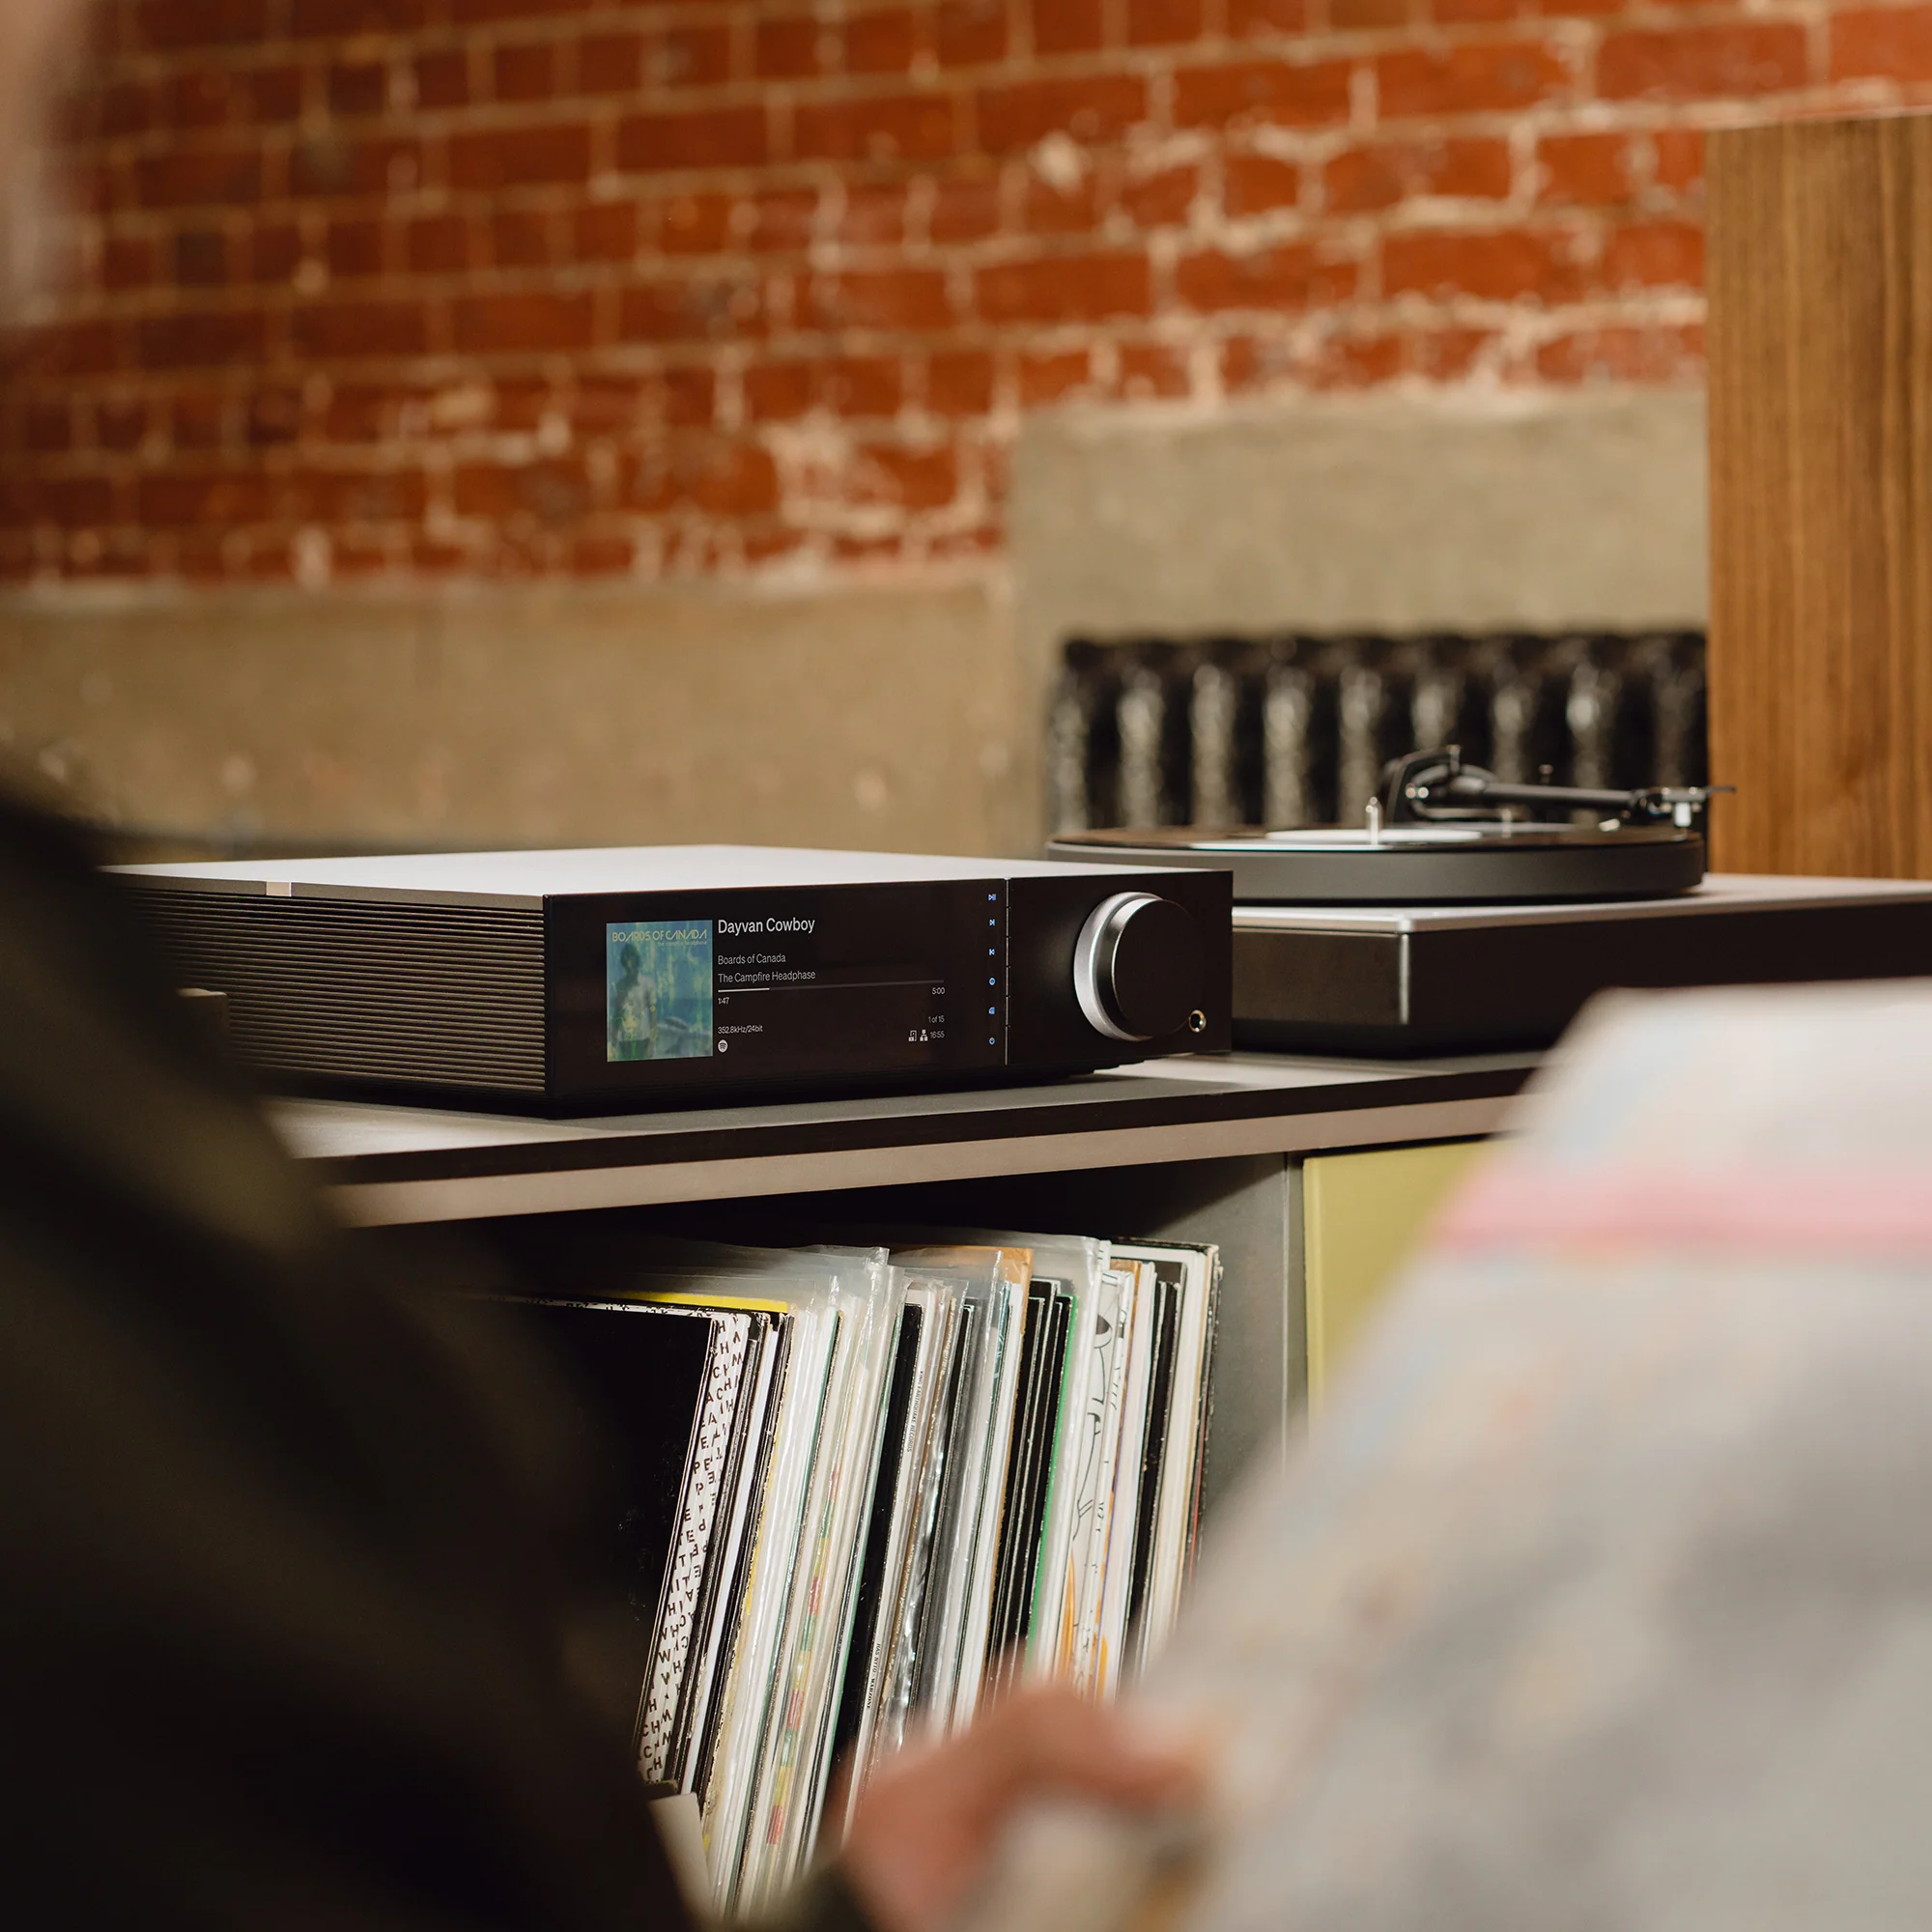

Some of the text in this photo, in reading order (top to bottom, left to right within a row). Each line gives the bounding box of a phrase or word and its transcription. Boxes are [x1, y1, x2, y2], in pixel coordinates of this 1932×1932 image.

[718, 917, 815, 936] Dayvan Cowboy
[611, 928, 707, 942] BOARDS OF CANADA
[718, 953, 786, 965] Boards of Canada
[718, 970, 816, 983] The Campfire Headphase
[931, 986, 946, 995] 5:00
[718, 996, 730, 1005] 1:47
[931, 1015, 938, 1024] of
[938, 1014, 946, 1023] 15
[717, 1024, 763, 1035] 352.8kHz/24bit
[907, 1425, 916, 1453] RECORDS
